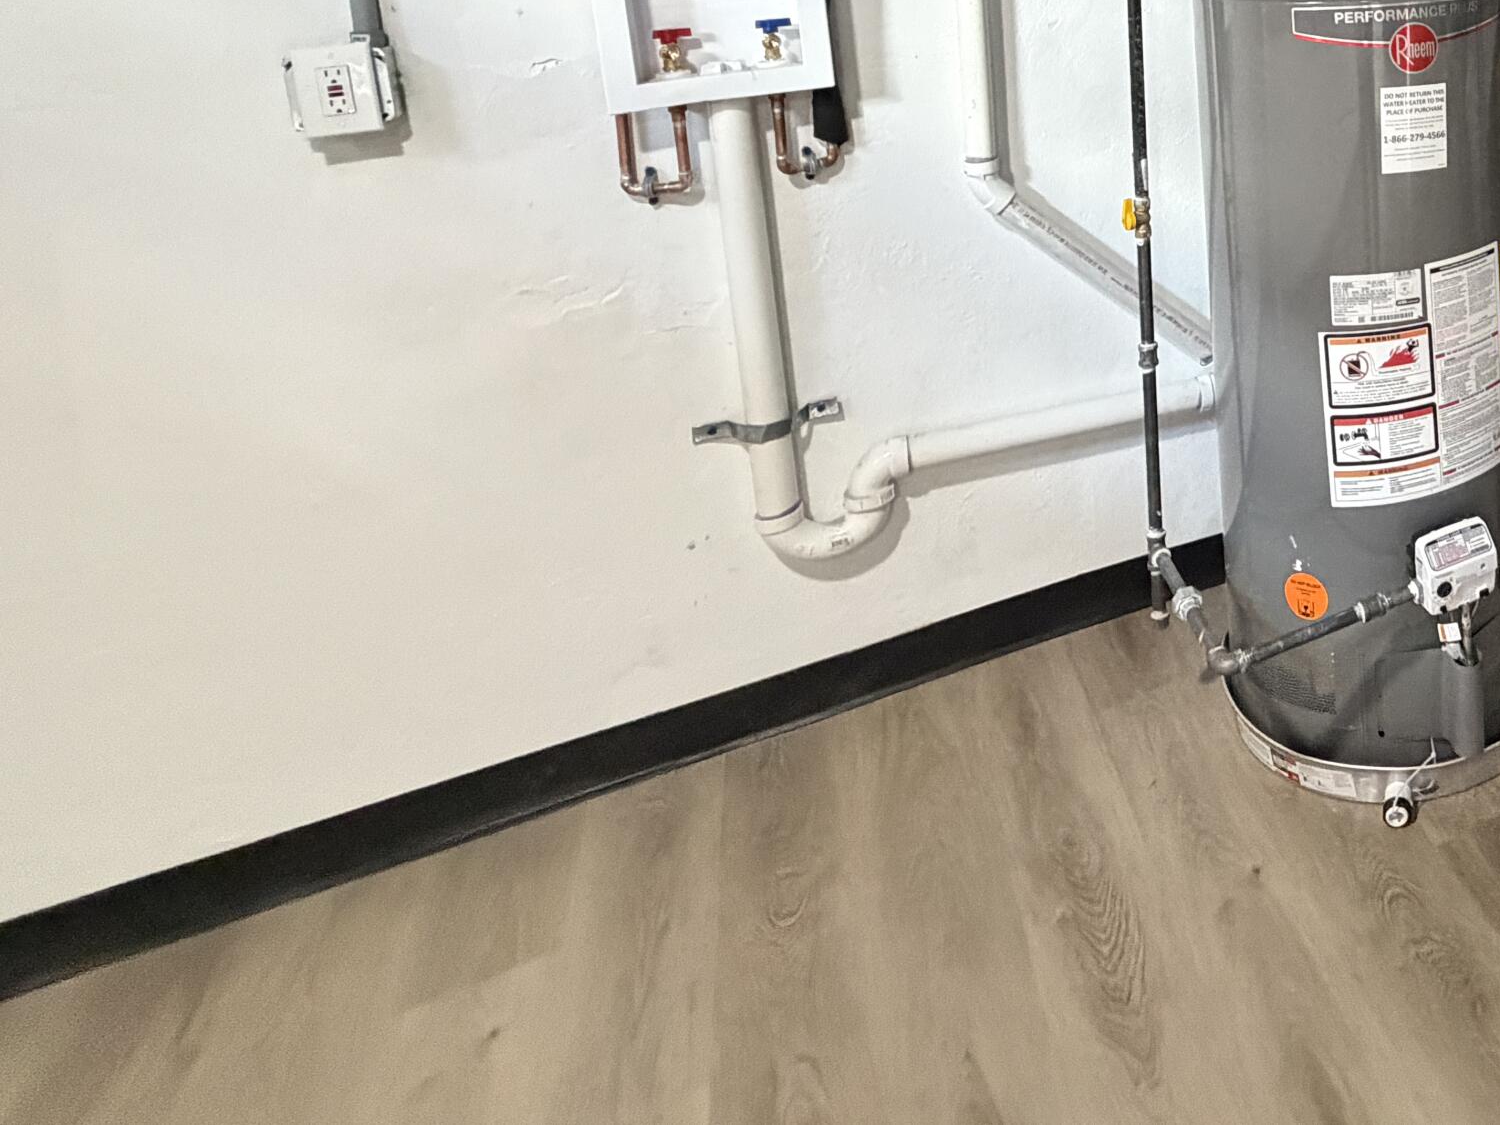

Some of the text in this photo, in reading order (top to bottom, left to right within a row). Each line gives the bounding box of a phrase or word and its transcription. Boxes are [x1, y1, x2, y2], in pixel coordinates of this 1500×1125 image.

[1334, 4, 1447, 25] PERFORMANCE
[1395, 33, 1436, 66] Rheem
[1409, 90, 1432, 98] RETURN
[1433, 88, 1445, 96] THIS
[1383, 100, 1404, 108] WATER
[1386, 108, 1404, 116] PLACE
[1414, 105, 1444, 114] PURCHASE
[1383, 130, 1446, 145] 1-866-279-4566
